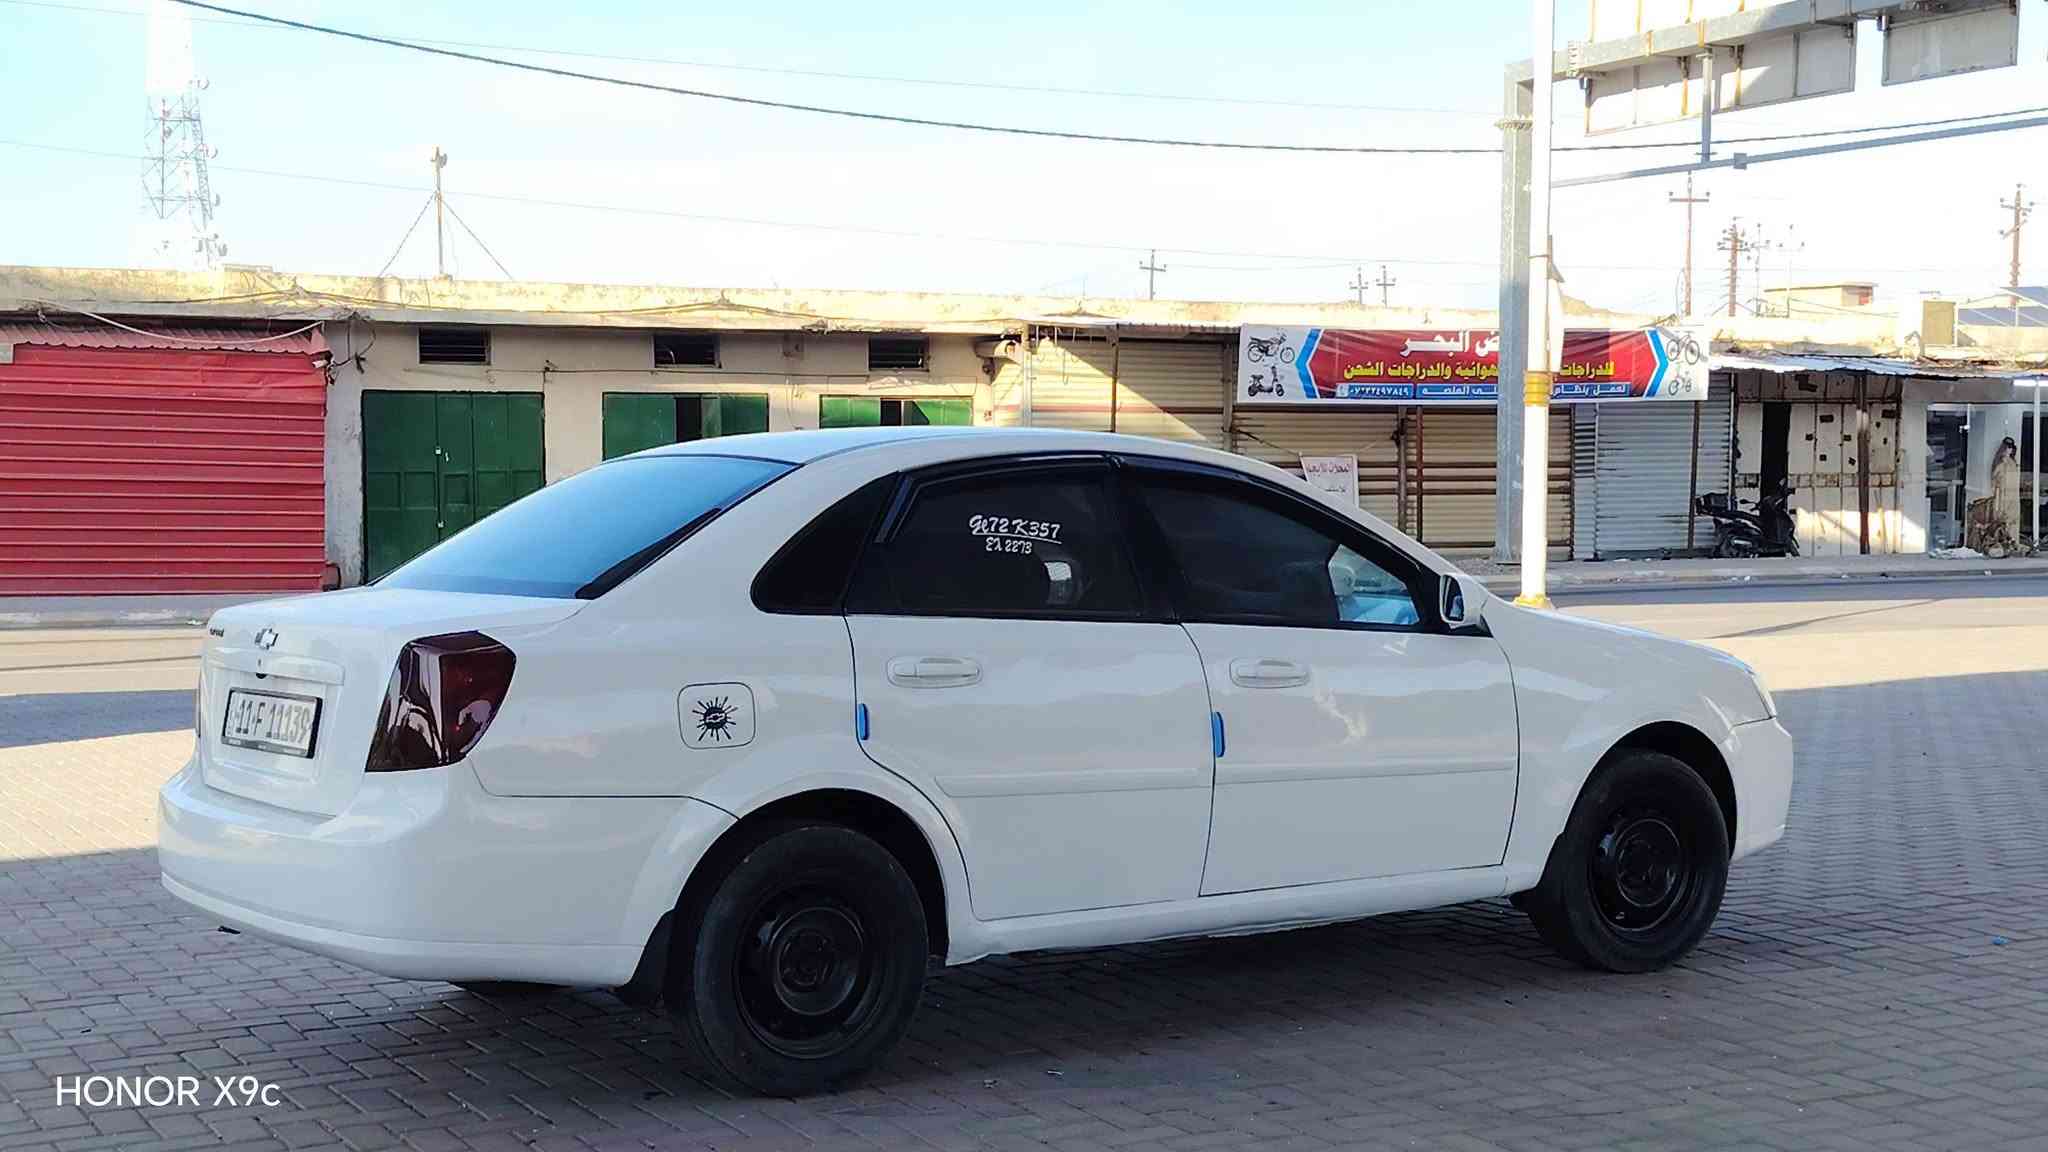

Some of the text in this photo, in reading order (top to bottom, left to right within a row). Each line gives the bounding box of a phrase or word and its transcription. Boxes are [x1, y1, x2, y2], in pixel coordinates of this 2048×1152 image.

[1400, 330, 1470, 357] البحر
[1388, 361, 1452, 380] والدراجات
[1456, 361, 1499, 379] هوائية
[1560, 362, 1615, 379] للدراجات
